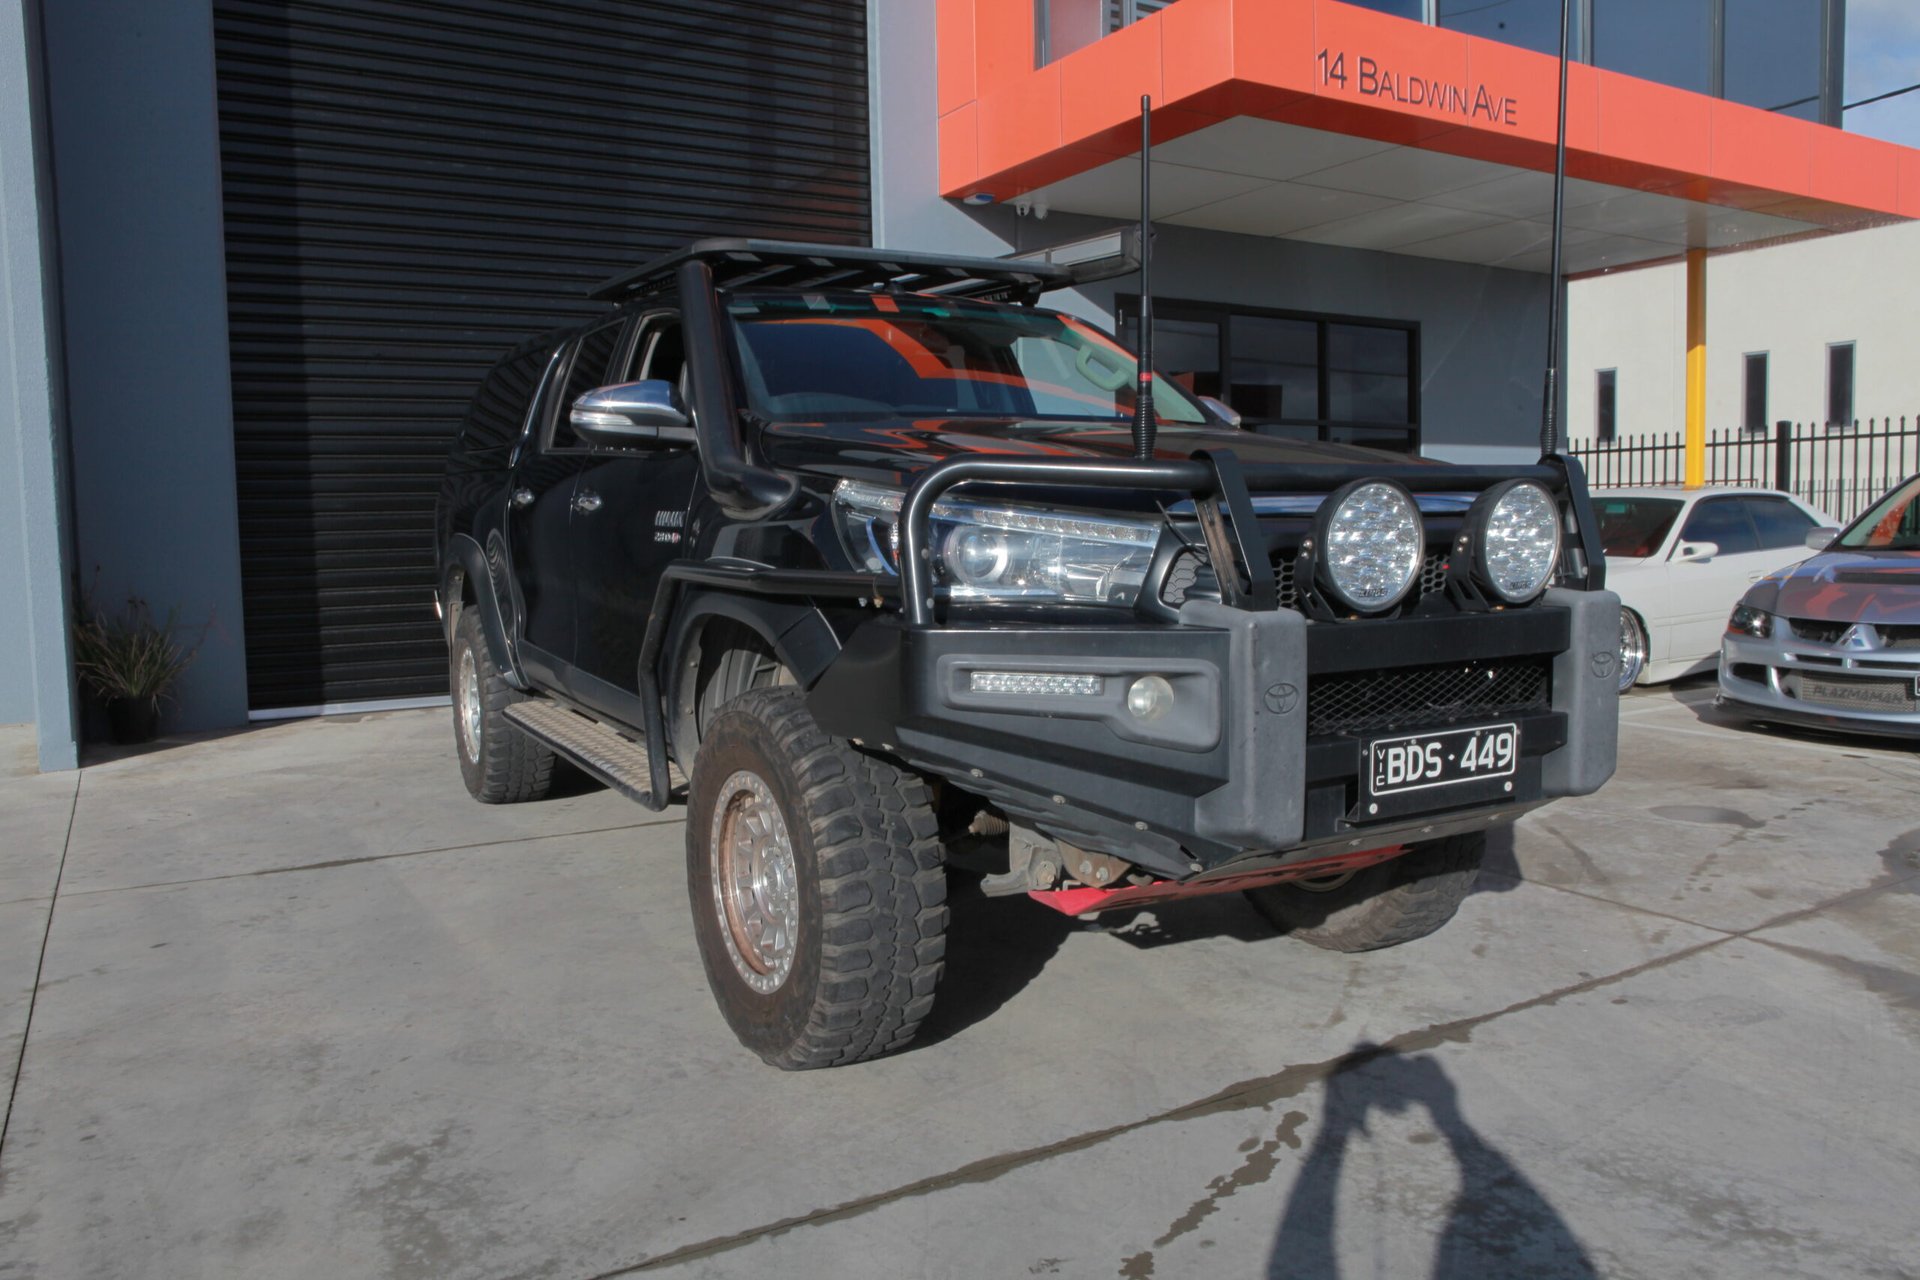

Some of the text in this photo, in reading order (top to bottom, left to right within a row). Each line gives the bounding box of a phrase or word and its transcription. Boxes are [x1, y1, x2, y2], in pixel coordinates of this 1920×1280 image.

[1316, 48, 1518, 126] 14 BALDWIN AVE
[1375, 749, 1386, 787] VIC
